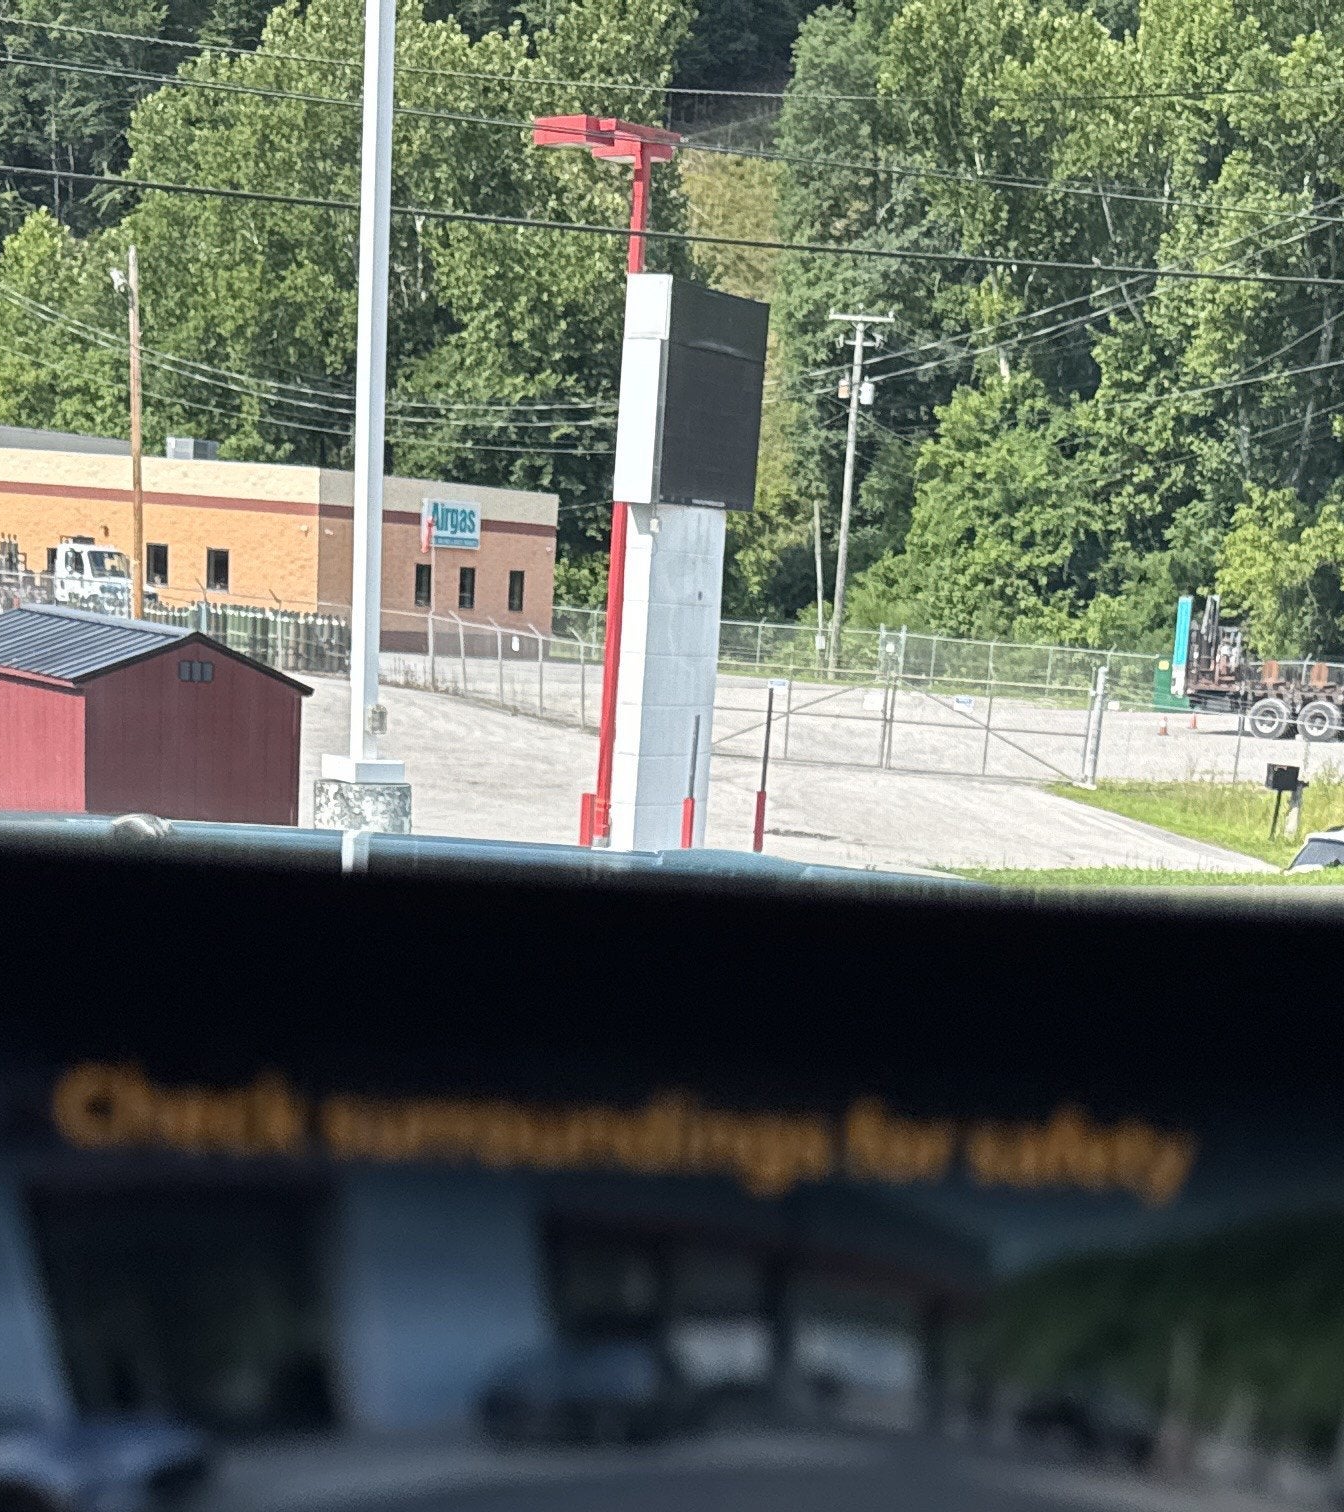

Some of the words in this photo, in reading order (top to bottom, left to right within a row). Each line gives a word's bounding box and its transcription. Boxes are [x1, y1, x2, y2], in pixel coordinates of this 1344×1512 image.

[432, 502, 476, 534] Airgas
[54, 1062, 304, 1158] Check
[320, 1090, 830, 1193] surroundings
[845, 1096, 952, 1182] for
[965, 1106, 1196, 1208] safety
